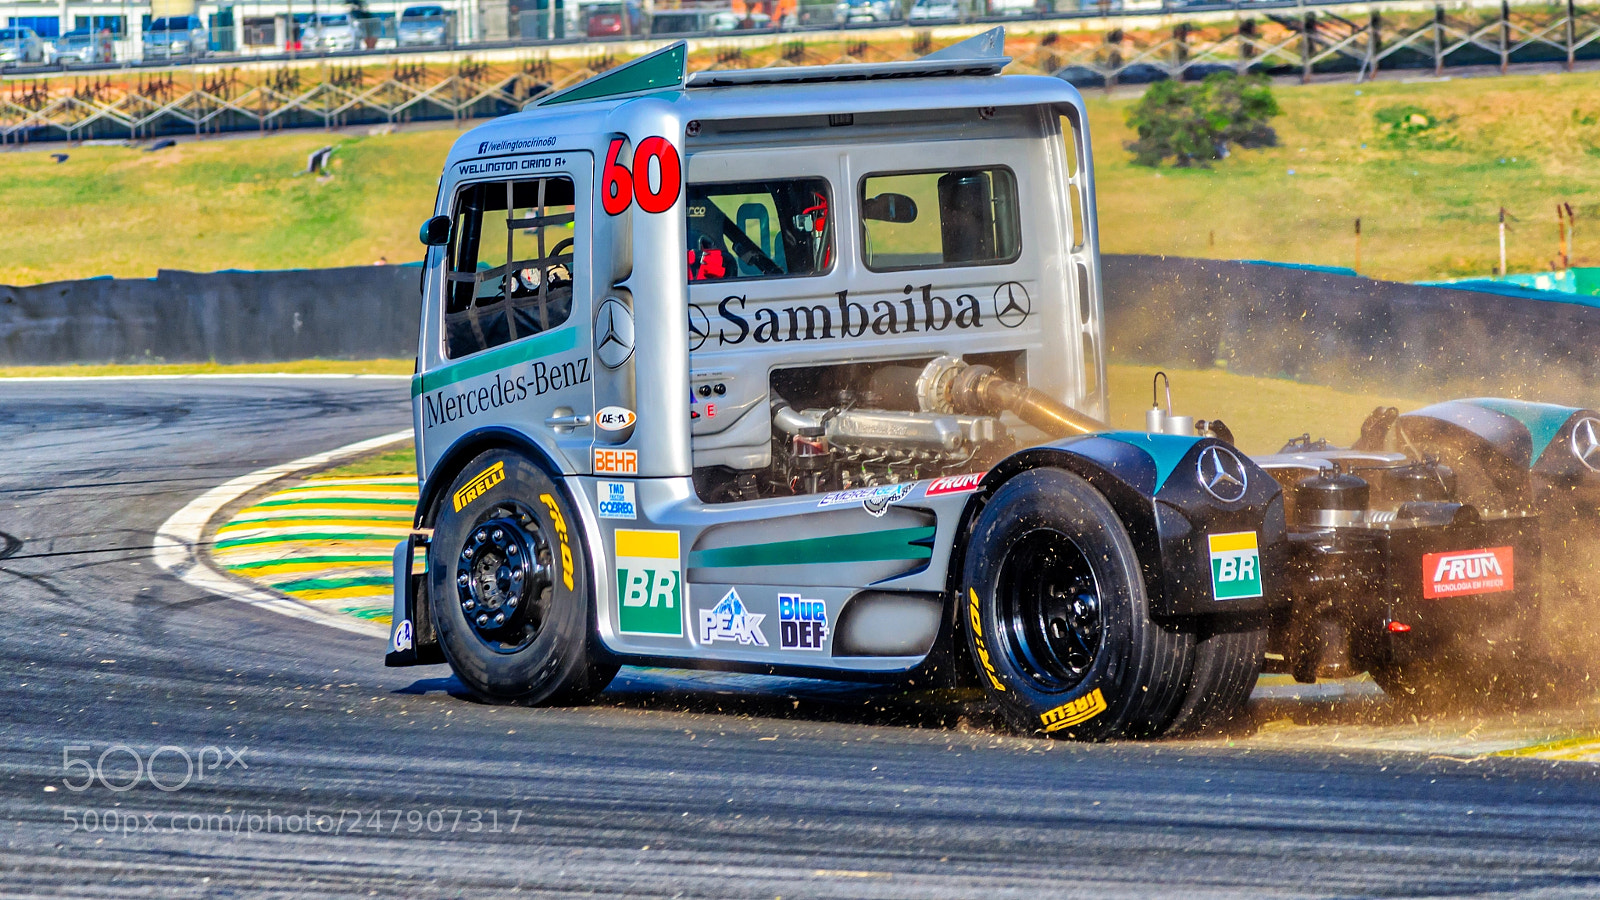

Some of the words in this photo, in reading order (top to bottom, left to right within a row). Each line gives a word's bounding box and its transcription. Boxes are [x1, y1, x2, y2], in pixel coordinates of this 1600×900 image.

[459, 161, 518, 175] WELLINGTON
[521, 159, 551, 169] CIRINO
[554, 157, 567, 167] A+
[602, 136, 682, 216] 60
[719, 284, 983, 345] Sambaiba
[425, 357, 591, 428] Mercedes-Benz
[595, 451, 637, 472] BEHR
[453, 460, 505, 513] PIRELLI
[609, 483, 624, 494] TMD
[929, 473, 980, 491] FRUM
[1218, 555, 1255, 582] BR
[1433, 552, 1503, 582] FRUM
[623, 568, 676, 608] BR
[1434, 582, 1473, 592] TECNOLOGIA
[1473, 581, 1481, 589] EM
[780, 596, 826, 621] Blue
[702, 611, 768, 646] PEAK
[780, 621, 825, 648] DEF
[1040, 688, 1107, 733] PIRELLI
